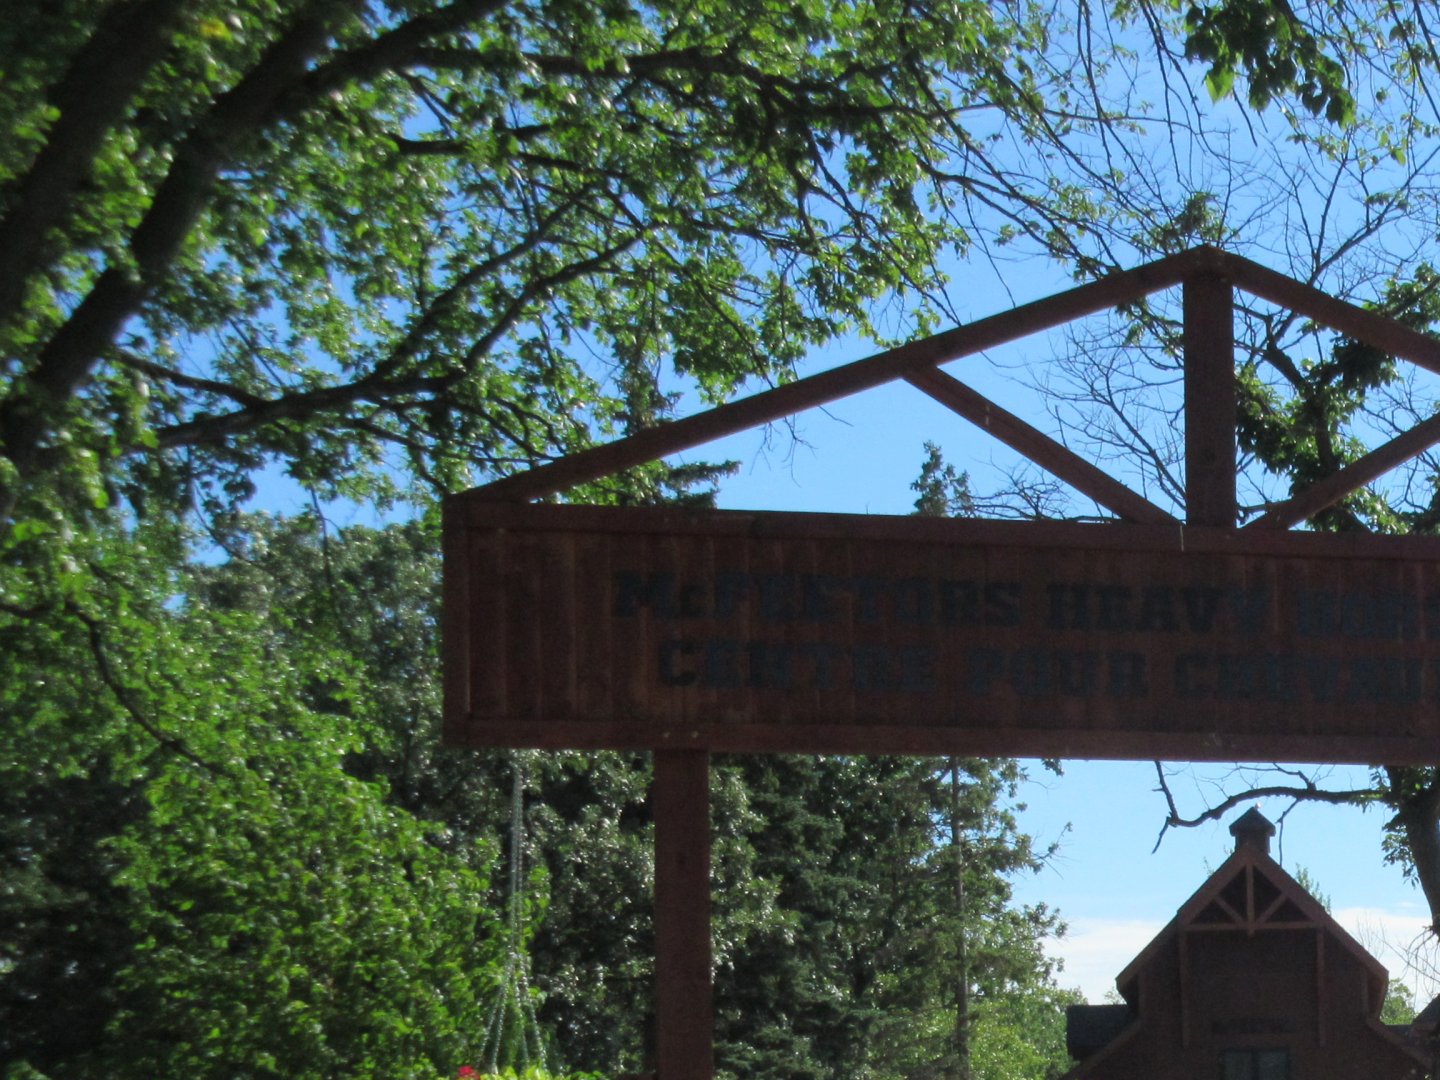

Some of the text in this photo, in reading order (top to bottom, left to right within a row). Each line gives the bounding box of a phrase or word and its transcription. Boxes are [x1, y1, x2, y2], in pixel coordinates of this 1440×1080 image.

[1046, 581, 1273, 635] HEAVY
[659, 638, 938, 691] CENTRE
[965, 645, 1149, 698] POUR
